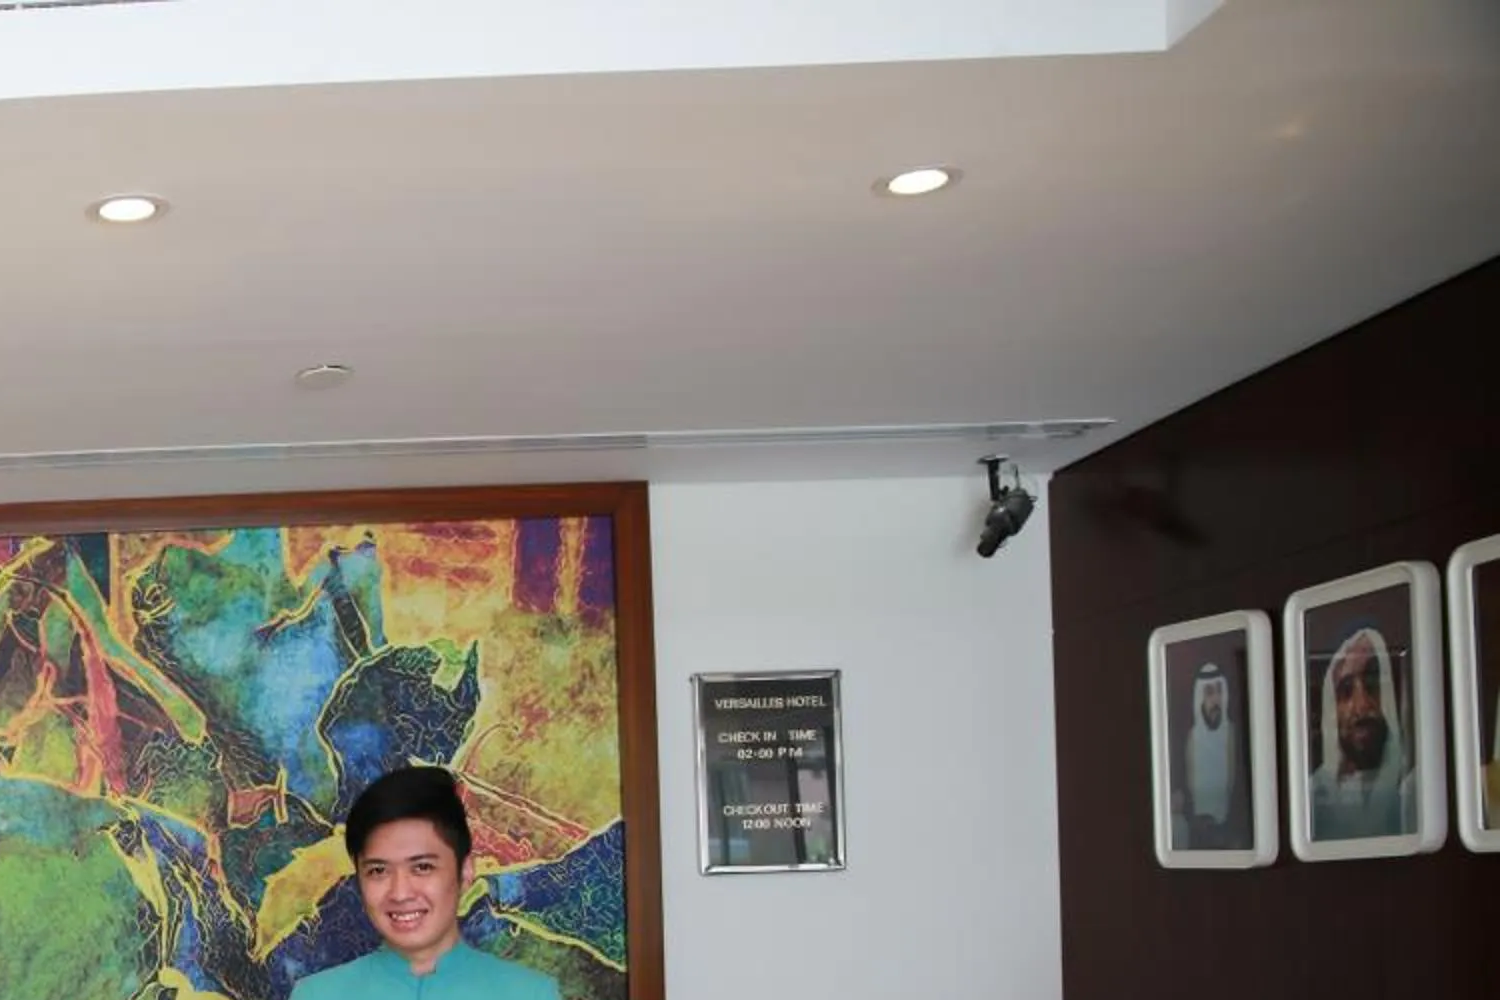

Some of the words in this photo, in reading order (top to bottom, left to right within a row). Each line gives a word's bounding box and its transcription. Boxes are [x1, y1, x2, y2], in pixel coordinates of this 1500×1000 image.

[786, 696, 827, 708] HOTEL
[718, 731, 760, 744] CHECK
[763, 731, 777, 741] IN
[788, 729, 817, 741] TIME
[795, 802, 825, 813] TIME
[774, 818, 812, 829] NOON
